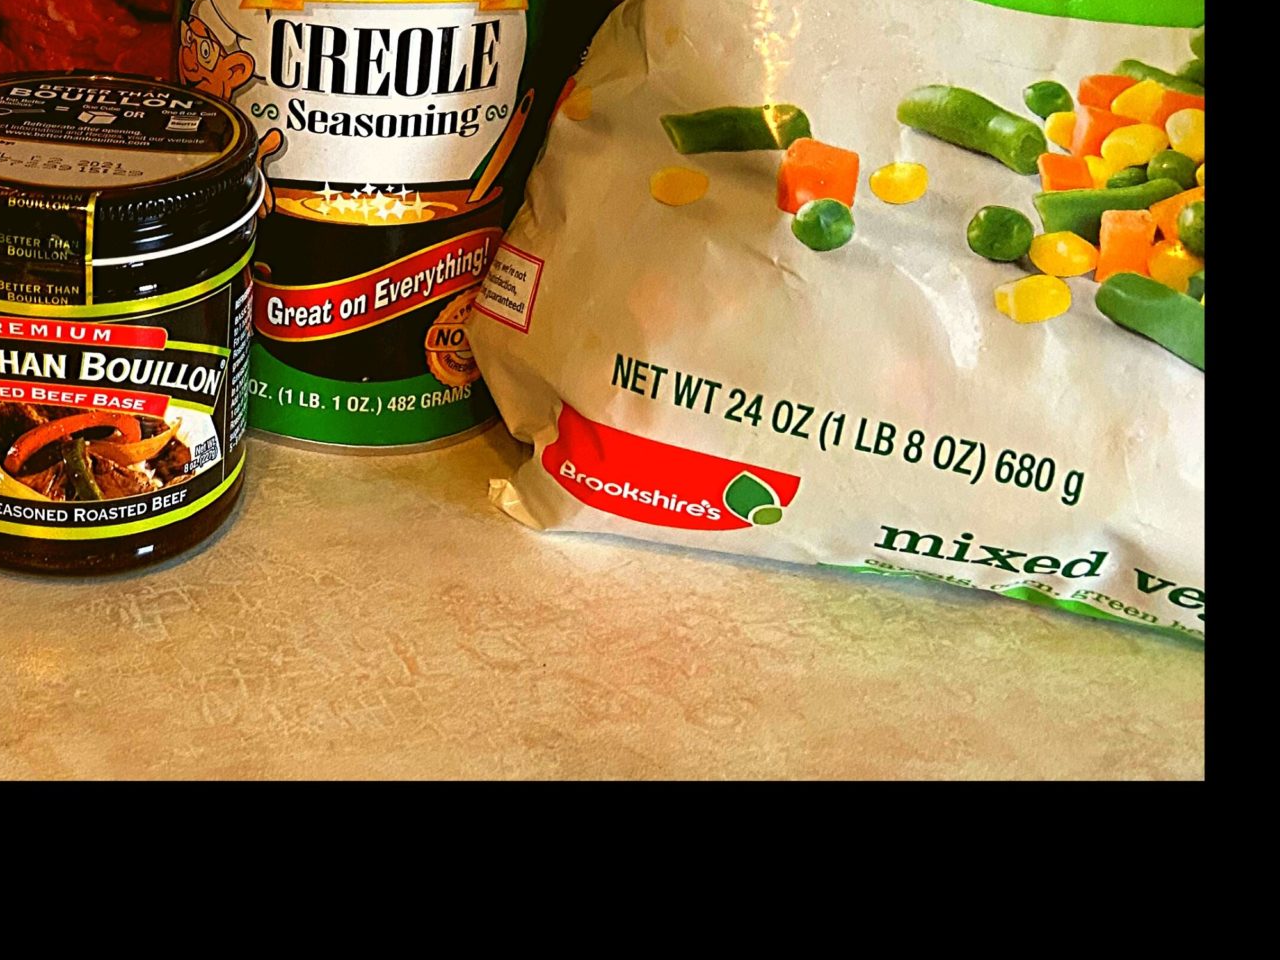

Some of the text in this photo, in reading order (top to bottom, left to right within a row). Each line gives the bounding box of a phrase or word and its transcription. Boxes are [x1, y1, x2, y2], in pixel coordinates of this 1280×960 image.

[271, 19, 500, 97] CREOLE
[9, 87, 195, 109] BOUILLON
[39, 83, 170, 100] BETTER THAN
[123, 110, 146, 119] OR
[288, 99, 482, 139] Seasoning
[46, 283, 80, 295] THAN
[267, 296, 332, 327] Great
[339, 292, 367, 317] on
[374, 237, 490, 309] Everything!
[79, 351, 222, 396] BOUILLON
[31, 387, 90, 405] BEEF
[93, 394, 147, 411] BASE
[278, 387, 293, 407] (1
[299, 394, 326, 411] LB.
[332, 396, 340, 411] 1
[347, 396, 383, 416] OZ.)
[387, 394, 416, 412] 482
[420, 386, 471, 409] GRAMS
[612, 352, 1086, 507] NET WT 24 OZ (1 LB 8 OZ) 680 g
[72, 501, 148, 523] ROASTED
[151, 488, 189, 513] BEEF
[558, 458, 722, 523] Brookshire's
[873, 524, 1108, 579] mixed
